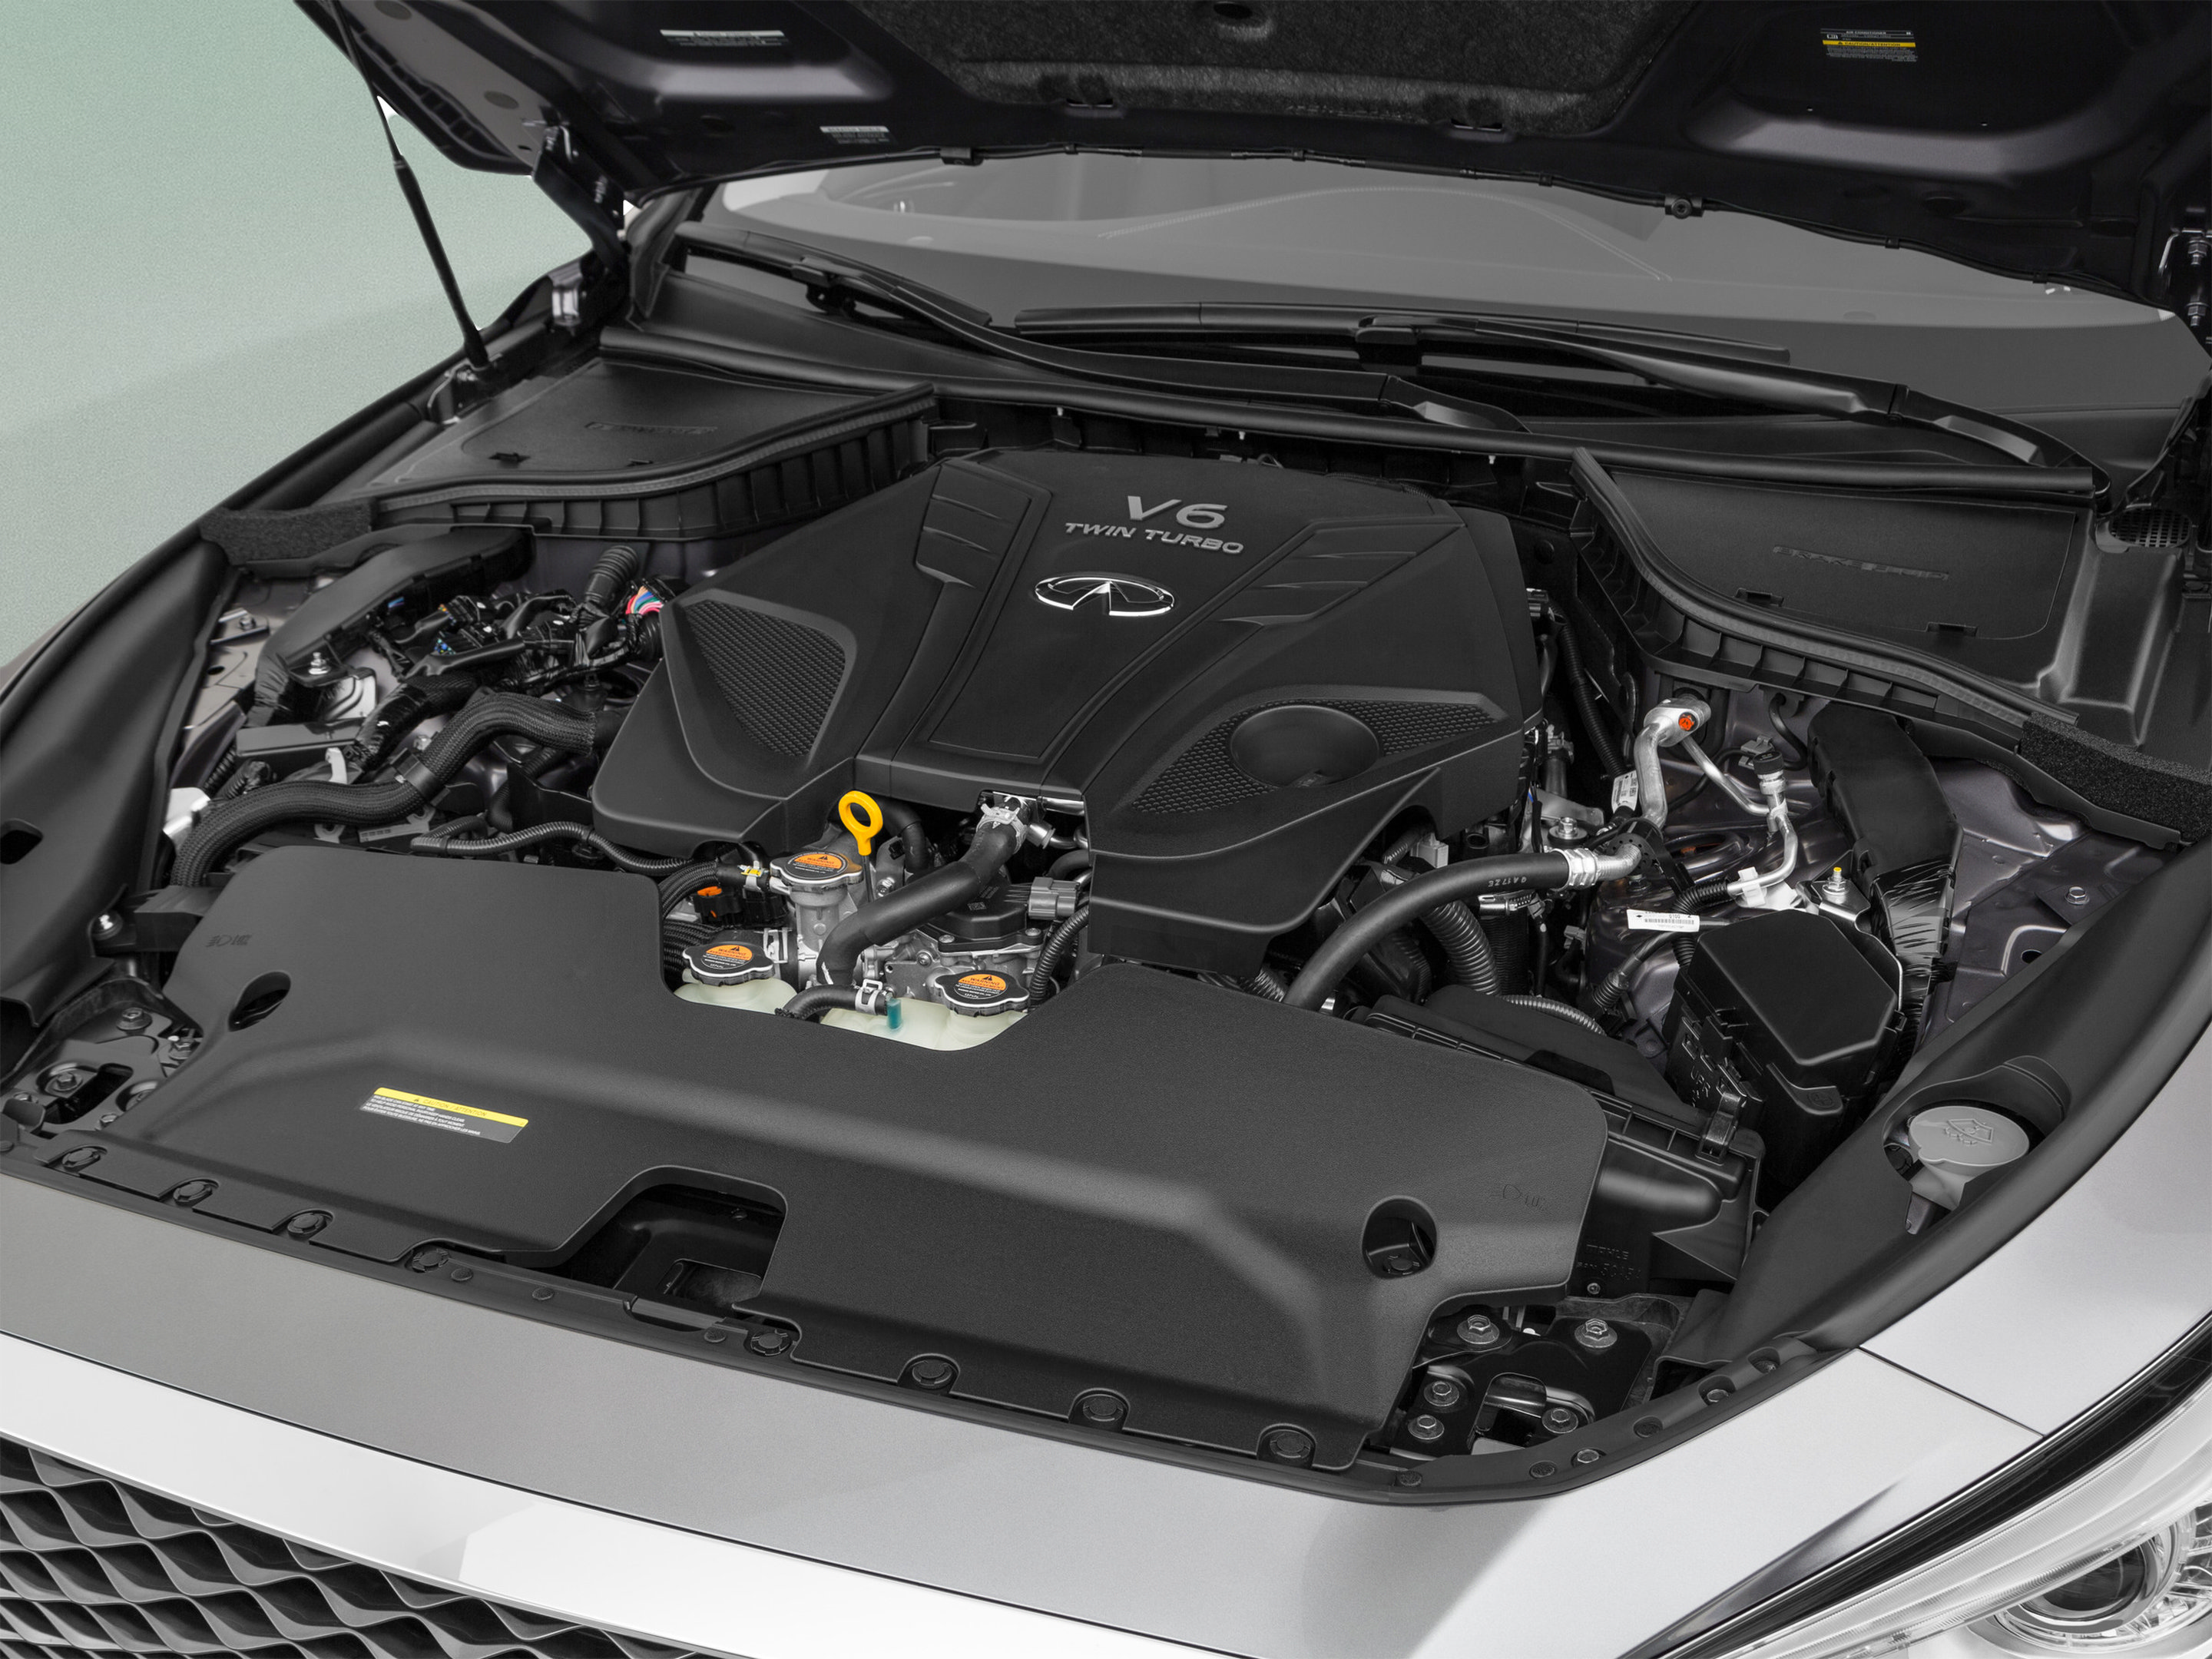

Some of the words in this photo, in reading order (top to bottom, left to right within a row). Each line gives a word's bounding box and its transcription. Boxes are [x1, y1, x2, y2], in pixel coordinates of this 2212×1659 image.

[1128, 495, 1228, 528] V6
[1065, 522, 1137, 538] TWIN
[1144, 529, 1244, 555] TURBO
[422, 1098, 449, 1108] CAUTION
